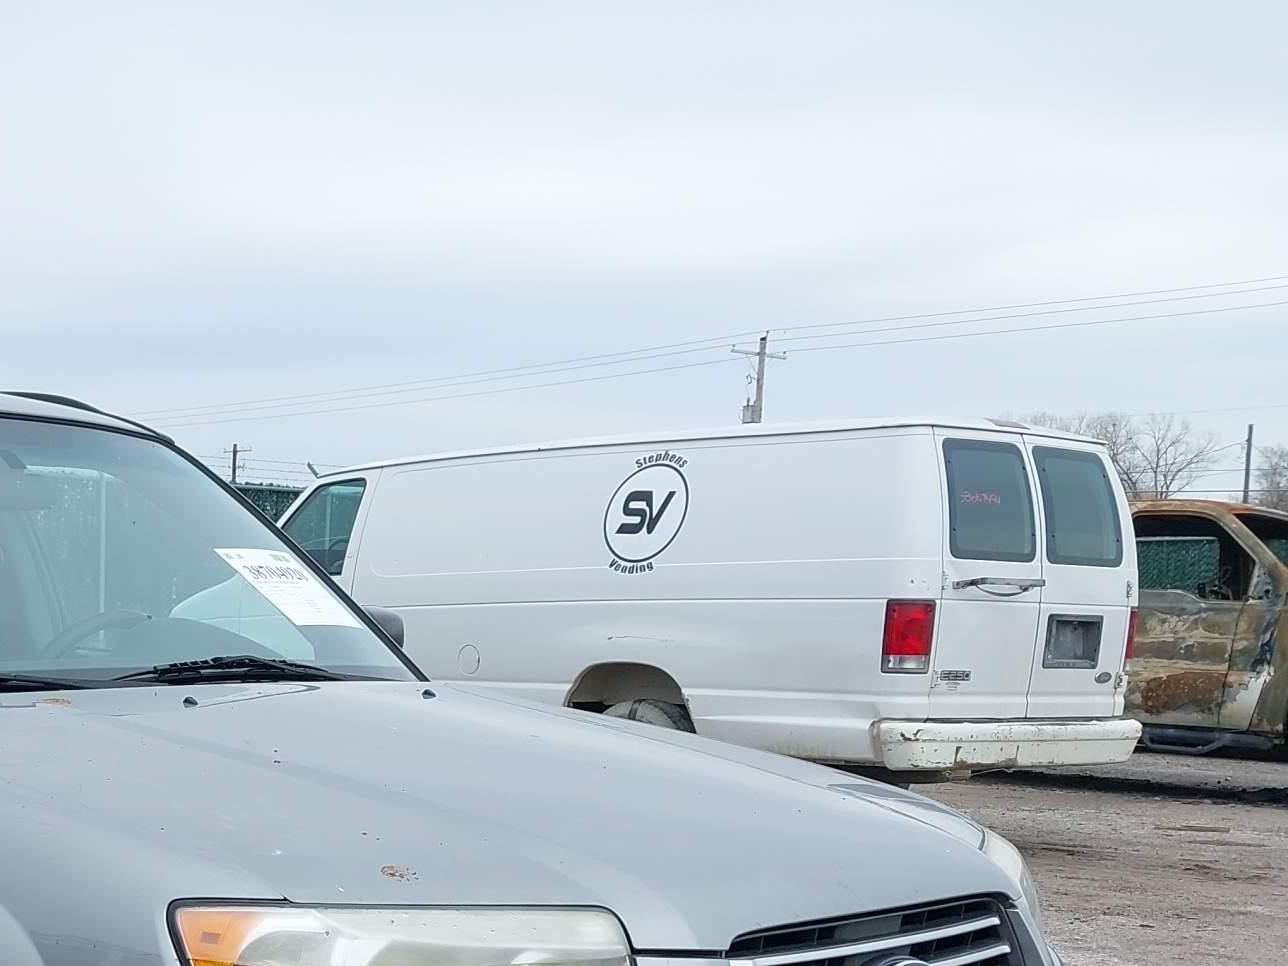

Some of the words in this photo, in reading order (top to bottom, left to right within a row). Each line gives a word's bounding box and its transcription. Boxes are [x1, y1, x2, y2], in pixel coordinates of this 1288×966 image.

[635, 451, 688, 468] Stephens
[614, 490, 677, 535] SV
[608, 558, 654, 574] Vending
[941, 670, 971, 680] E250
